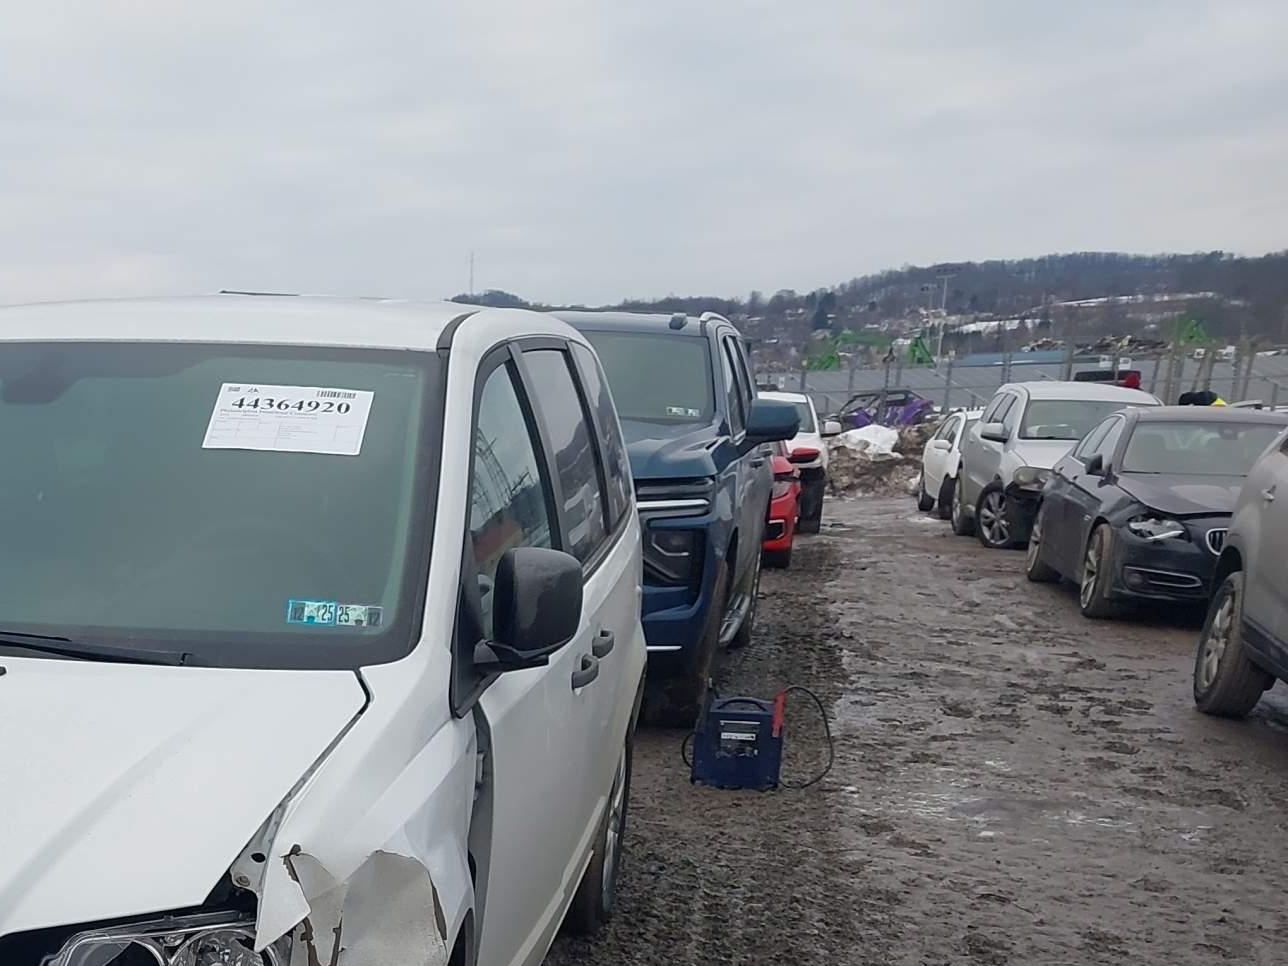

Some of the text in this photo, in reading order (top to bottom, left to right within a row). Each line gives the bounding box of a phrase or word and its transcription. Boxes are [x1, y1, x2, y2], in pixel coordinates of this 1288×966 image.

[231, 396, 352, 416] 44364920
[321, 604, 334, 621] 25
[338, 606, 350, 623] 25
